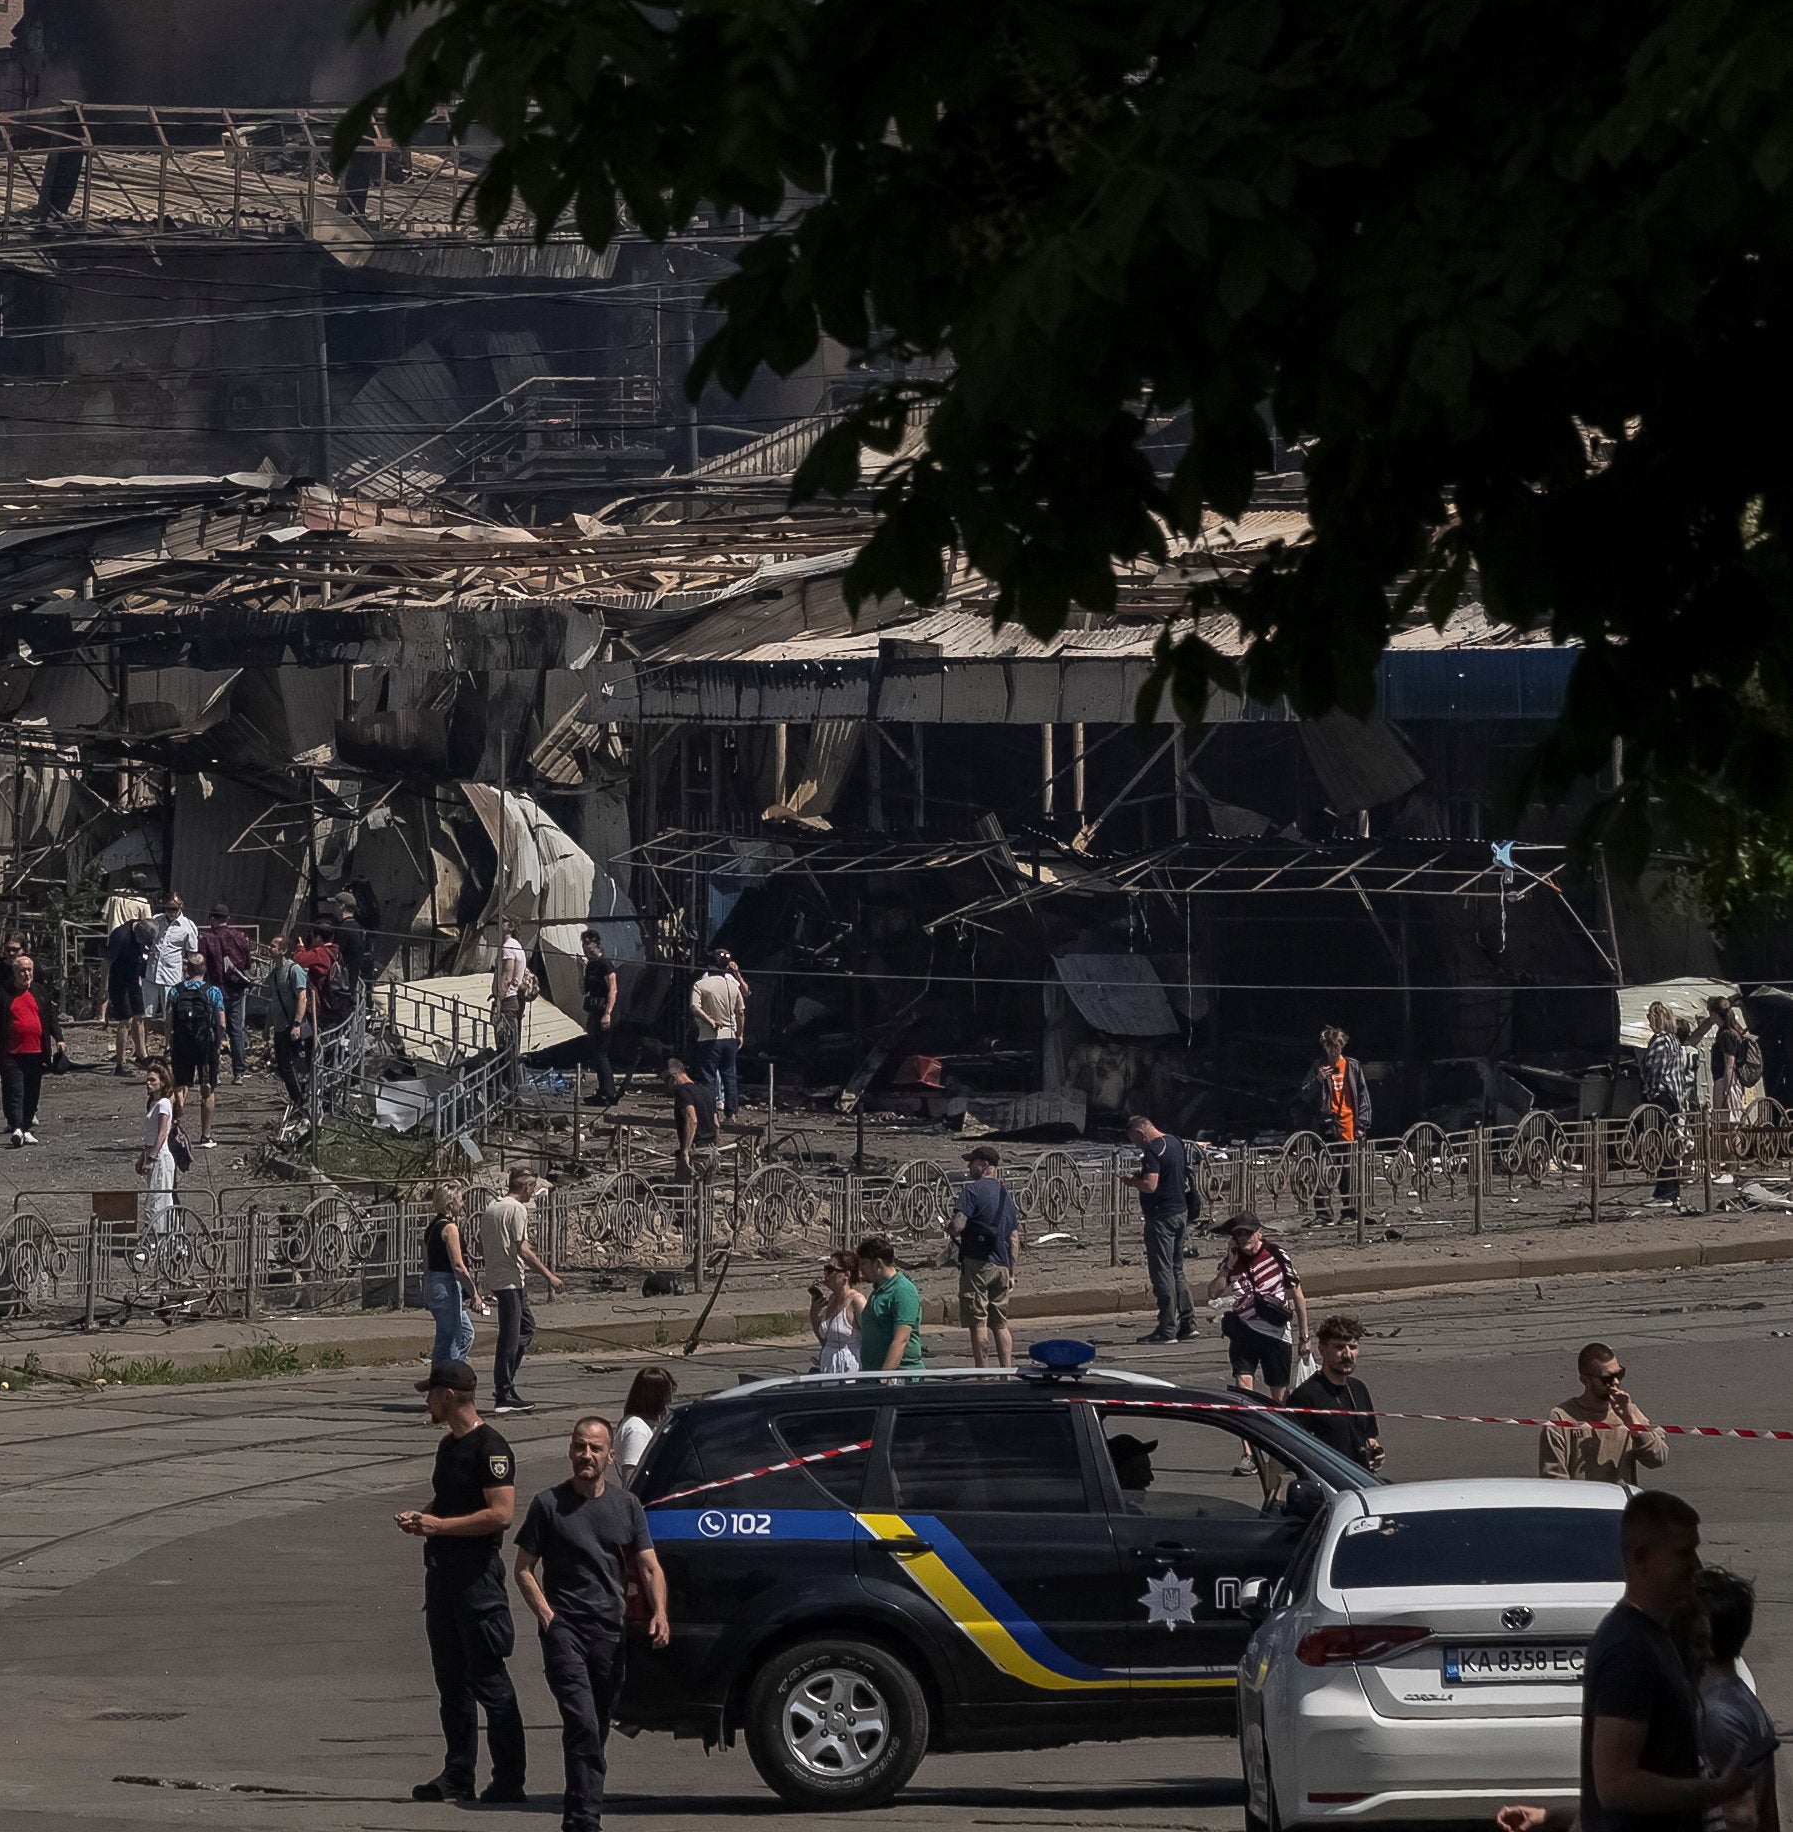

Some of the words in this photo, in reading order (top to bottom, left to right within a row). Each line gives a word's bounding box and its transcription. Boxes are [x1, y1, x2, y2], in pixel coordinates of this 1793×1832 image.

[731, 1513, 772, 1534] 102
[1461, 1651, 1493, 1672] KA
[1498, 1650, 1548, 1672] 8358
